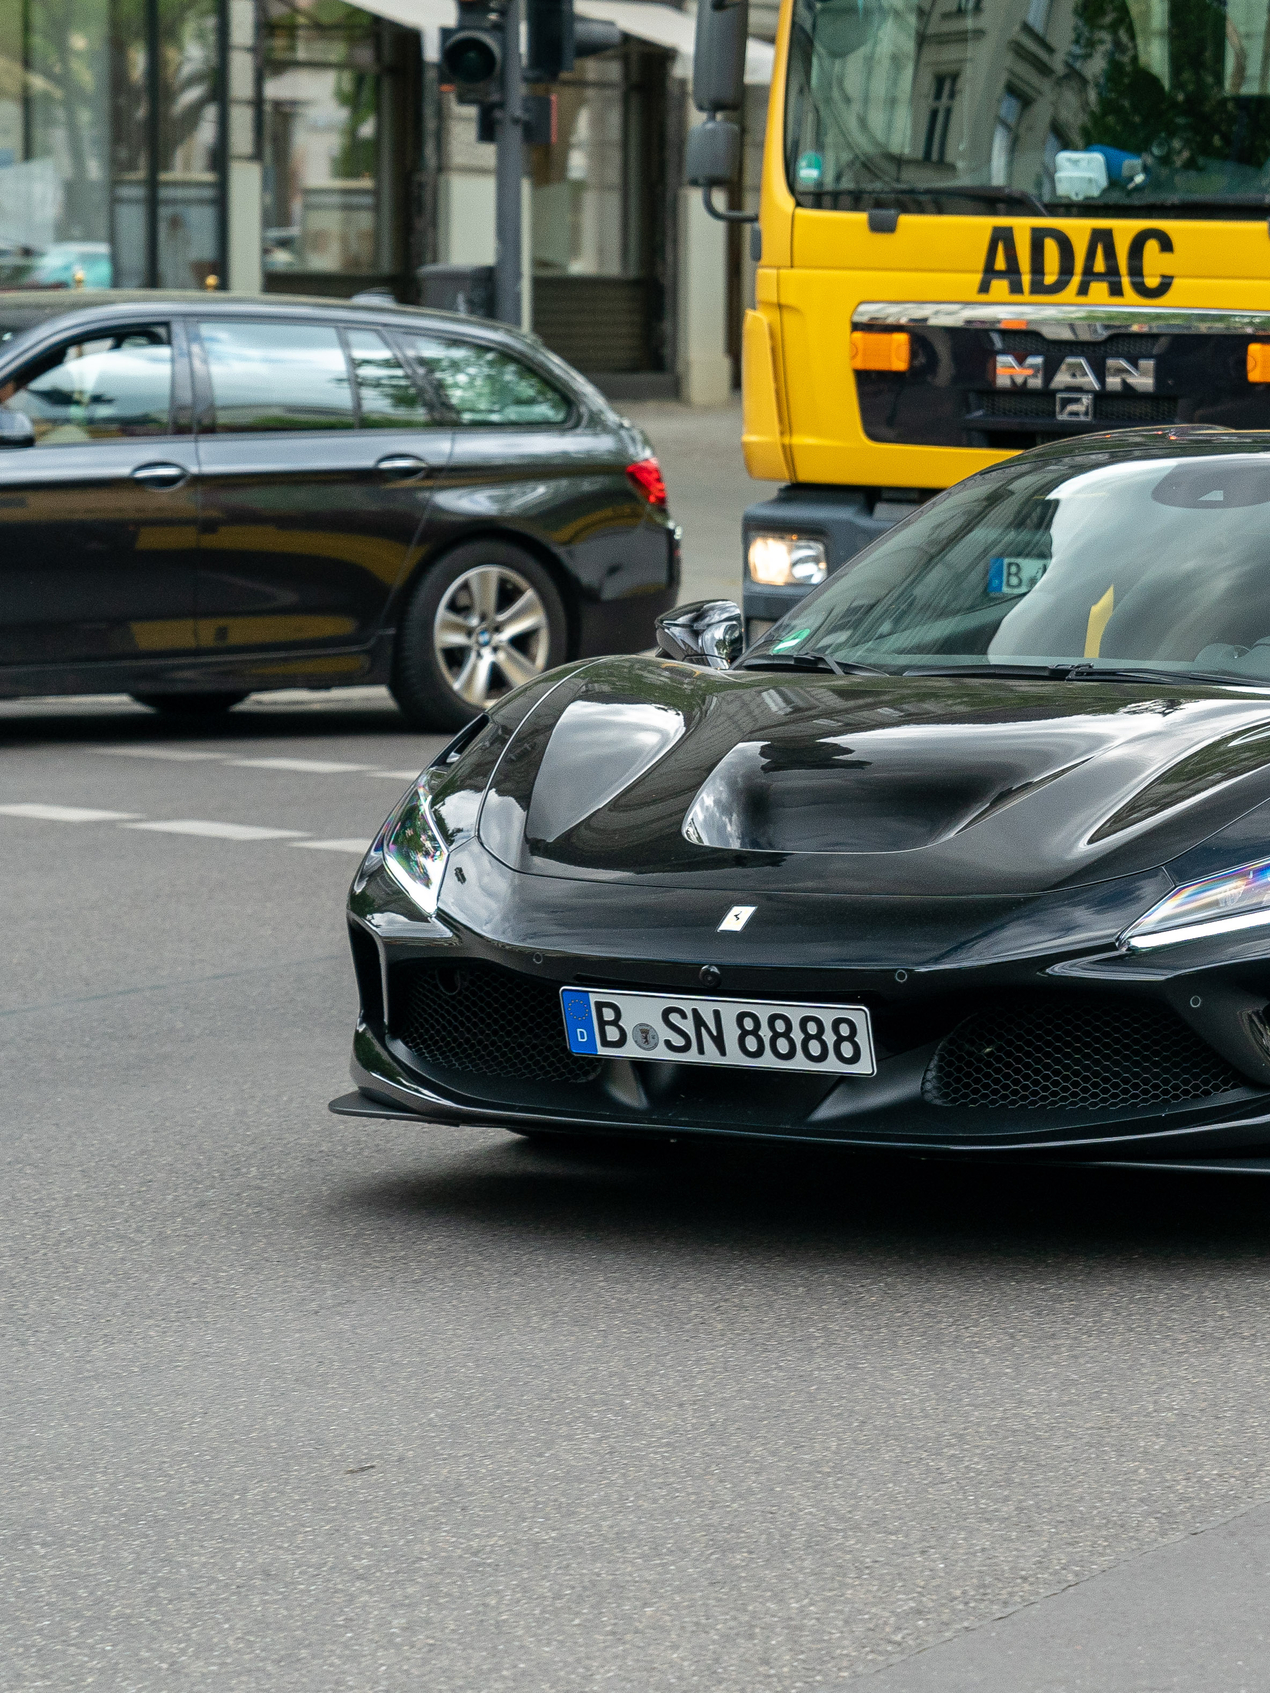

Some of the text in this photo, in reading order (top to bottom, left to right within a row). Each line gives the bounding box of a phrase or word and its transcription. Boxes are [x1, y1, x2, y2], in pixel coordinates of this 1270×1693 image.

[977, 226, 1175, 300] ADAC
[995, 353, 1157, 393] MAN
[1005, 561, 1023, 589] B
[577, 1000, 862, 1065] D B SN 8888
